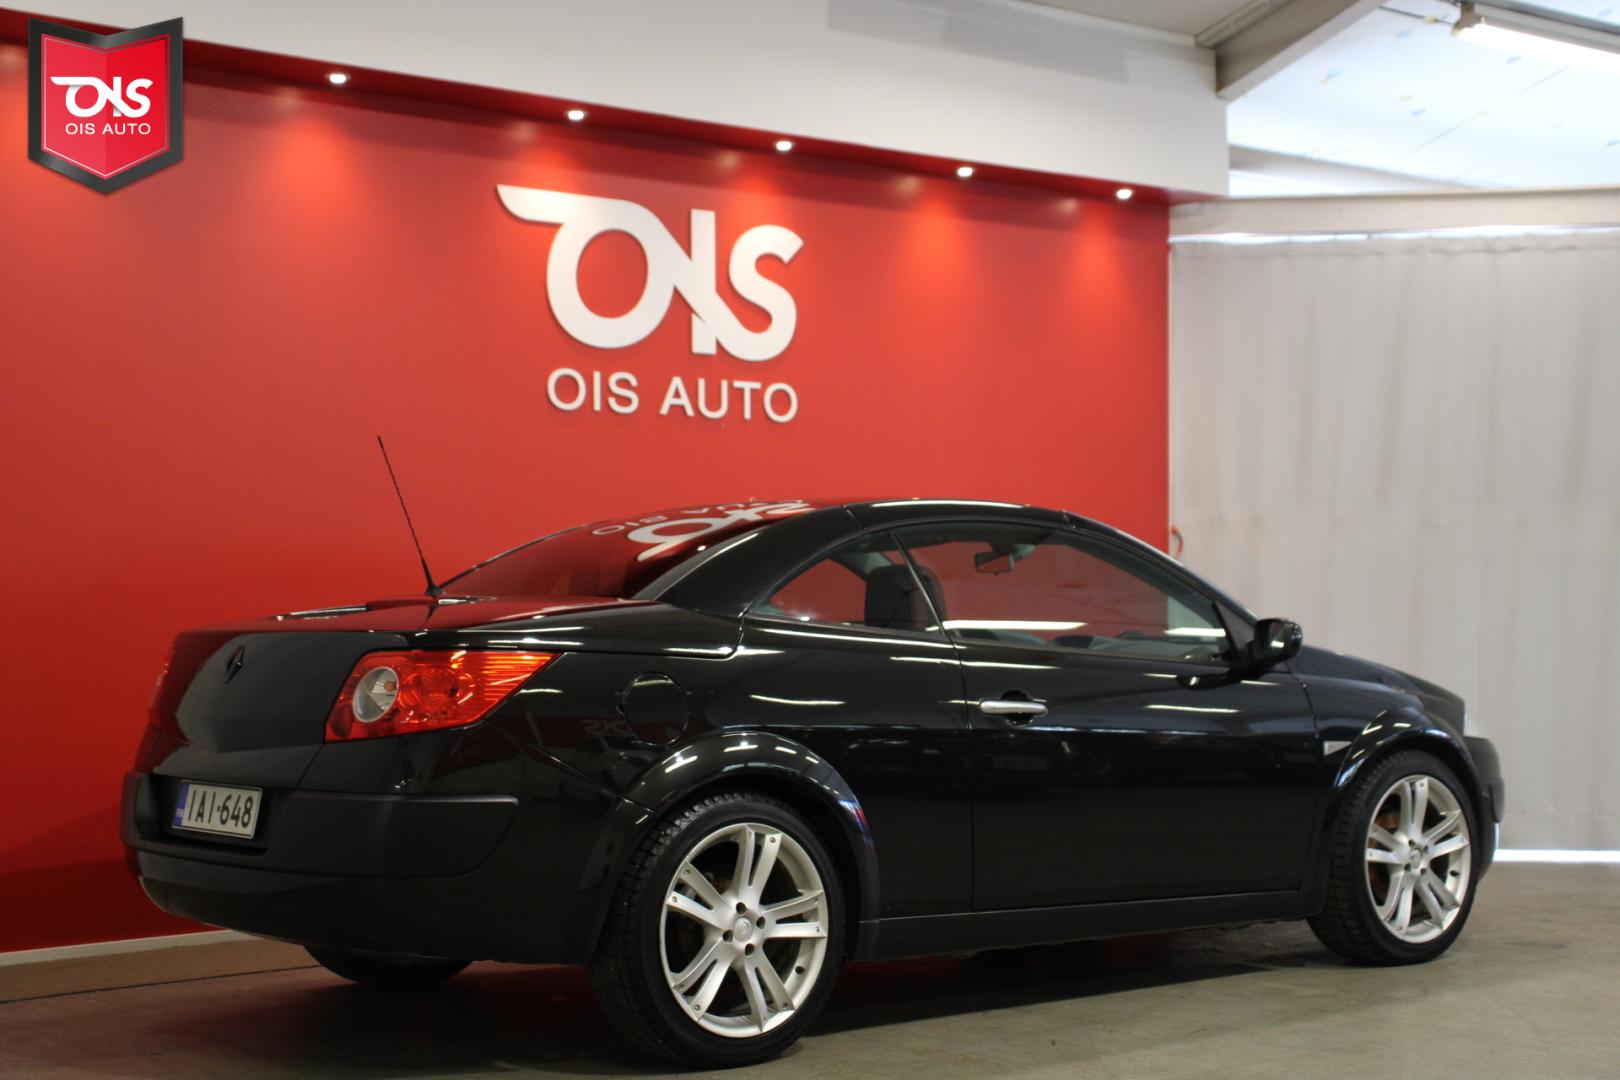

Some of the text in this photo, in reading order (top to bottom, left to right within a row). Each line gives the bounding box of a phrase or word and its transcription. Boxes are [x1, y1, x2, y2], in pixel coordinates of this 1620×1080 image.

[496, 184, 804, 361] OIS
[546, 367, 798, 422] OIS AUTO
